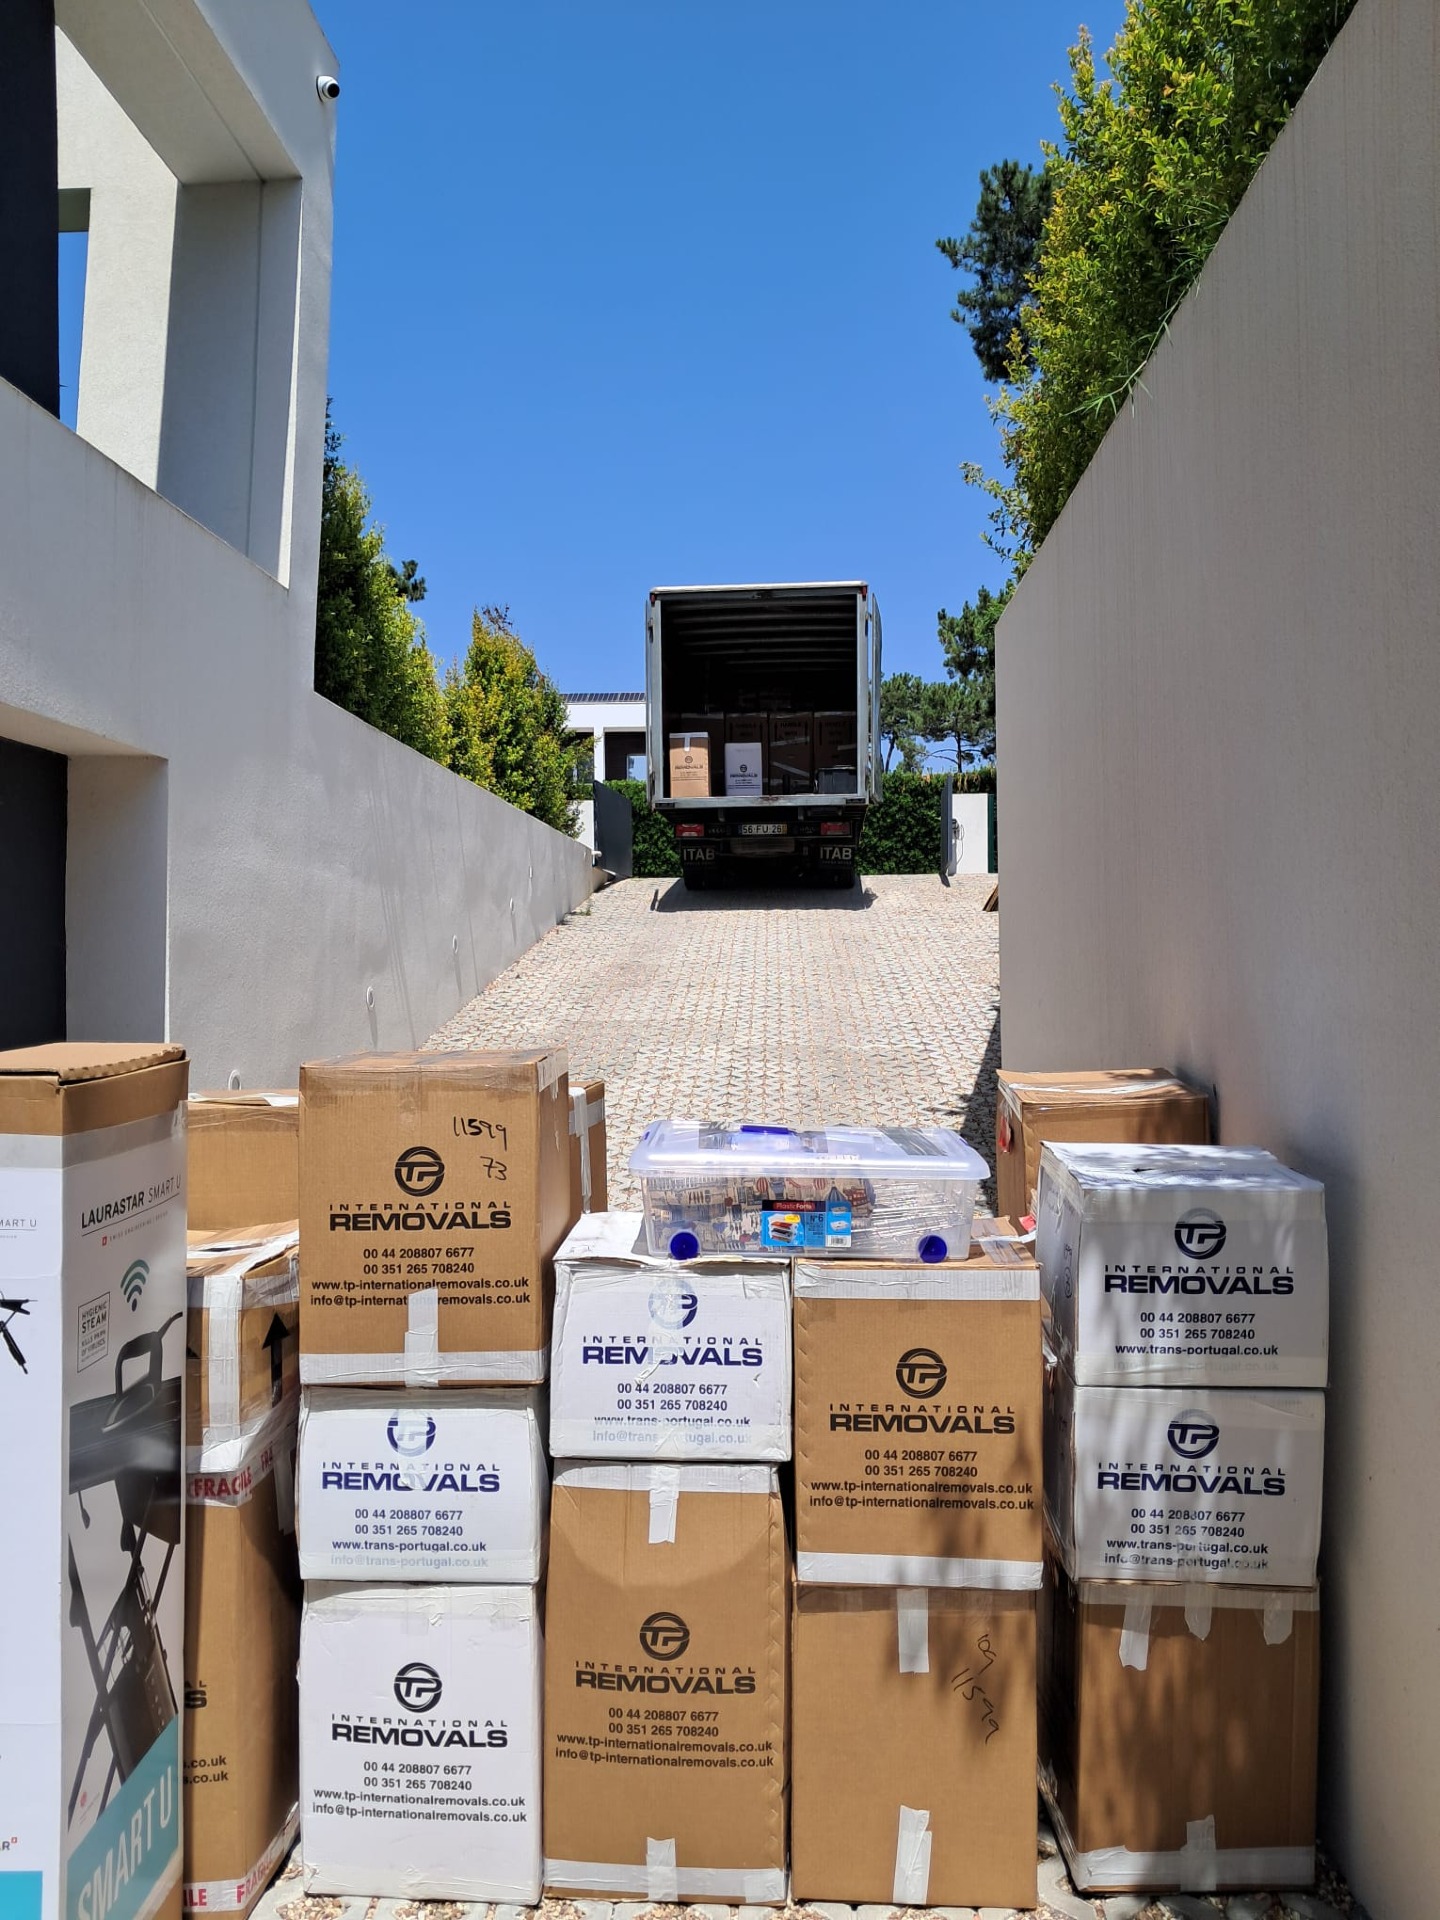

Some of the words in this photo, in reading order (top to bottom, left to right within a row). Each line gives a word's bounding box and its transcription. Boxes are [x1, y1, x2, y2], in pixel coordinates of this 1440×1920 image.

[683, 848, 715, 861] ITAB
[819, 847, 852, 860] ITAB
[480, 1156, 507, 1181] 73
[81, 1191, 145, 1229] LAURASTAR
[148, 1176, 175, 1203] SMART
[176, 1173, 182, 1190] U
[330, 1201, 511, 1211] INTERNATIONAL
[29, 1219, 37, 1228] U
[329, 1210, 512, 1231] REMOVALS
[363, 1248, 378, 1259] 00
[381, 1248, 396, 1259] 44
[399, 1248, 442, 1259] 208807
[445, 1247, 475, 1258] 6677
[363, 1264, 378, 1275] 00
[381, 1264, 402, 1275] 351
[406, 1264, 428, 1275] 265
[431, 1263, 475, 1274] 708240
[1105, 1264, 1294, 1274] INTERNATIONAL
[311, 1277, 529, 1292] www.tp-internationalremovals.co.uk
[1104, 1275, 1294, 1295] REMOVALS
[310, 1292, 531, 1309] info@tp-internatremovals.co.uk
[82, 1311, 107, 1334] STEAM
[1140, 1312, 1155, 1323] 00
[1159, 1312, 1174, 1323] 44
[1177, 1313, 1222, 1324] 208807
[1225, 1313, 1256, 1324] 6677
[1140, 1328, 1155, 1339] 00
[1158, 1328, 1180, 1339] 351
[1184, 1328, 1207, 1339] 265
[1210, 1328, 1255, 1340] 708240
[1115, 1344, 1278, 1356] www.trans-portugal.co.uk
[617, 1383, 632, 1394] 00
[635, 1383, 650, 1394] 44
[653, 1384, 695, 1395] 208807
[698, 1384, 728, 1395] 6677
[617, 1399, 632, 1410] 00
[635, 1399, 655, 1410] 351
[660, 1400, 681, 1411] 265
[685, 1400, 728, 1411] 708240
[830, 1403, 1015, 1414] INTERNATIONAL
[830, 1413, 1015, 1434] REMOVALS
[864, 1450, 880, 1461] 00
[883, 1450, 898, 1461] 44
[901, 1450, 944, 1461] 208807
[948, 1451, 977, 1462] 6677
[864, 1465, 880, 1476] 00
[883, 1465, 904, 1476] 351
[908, 1466, 931, 1477] 265
[933, 1466, 978, 1477] 708240
[1099, 1462, 1286, 1476] INTERNATIONAL
[193, 1466, 252, 1497] FRAGILE
[322, 1471, 500, 1492] REMOVALS
[811, 1480, 1033, 1494] www.tp-internationalremovals.co.uk
[1097, 1472, 1286, 1496] REMOVALS
[809, 1495, 1034, 1510] info@tp-internationalremovals.co.uk
[354, 1508, 369, 1519] 00
[372, 1508, 386, 1519] 44
[389, 1509, 431, 1520] 208807
[434, 1509, 463, 1521] 6677
[1131, 1508, 1146, 1519] 00
[1150, 1508, 1164, 1519] 44
[1215, 1511, 1245, 1522] 6677
[354, 1524, 369, 1535] 00
[372, 1524, 392, 1535] 351
[396, 1525, 417, 1536] 265
[421, 1525, 463, 1536] 708240
[1130, 1524, 1145, 1534] 00
[1149, 1524, 1170, 1535] 351
[332, 1539, 487, 1553] www.trans-portugal.co.uk
[575, 1660, 756, 1675] INTERNATIONAL
[575, 1670, 756, 1695] REMOVALS
[332, 1713, 508, 1728] INTERNATIONAL
[608, 1708, 623, 1718] 00
[626, 1708, 641, 1719] 44
[644, 1709, 687, 1721] 208807
[690, 1711, 719, 1722] 6677
[332, 1723, 508, 1748] REMOVALS
[608, 1723, 623, 1734] 00
[626, 1724, 647, 1735] 351
[651, 1725, 672, 1736] 265
[676, 1726, 719, 1738] 708240
[556, 1733, 773, 1753] www.tp-internationalremovals.co.uk
[555, 1747, 774, 1768] info@tp-internationalremovals.co.uk
[363, 1761, 378, 1772] 00
[381, 1762, 395, 1773] 44
[398, 1763, 440, 1775] 208807
[443, 1764, 472, 1776] 6677
[363, 1776, 378, 1787] 00
[381, 1777, 401, 1788] 351
[405, 1778, 426, 1790] 265
[430, 1779, 472, 1791] 708240
[314, 1789, 526, 1808] www.tp-internationalremovals.co.uk
[312, 1802, 527, 1823] info@tp-internationalremovals.co.uk
[78, 1786, 155, 1920] SMART
[160, 1765, 172, 1829] U
